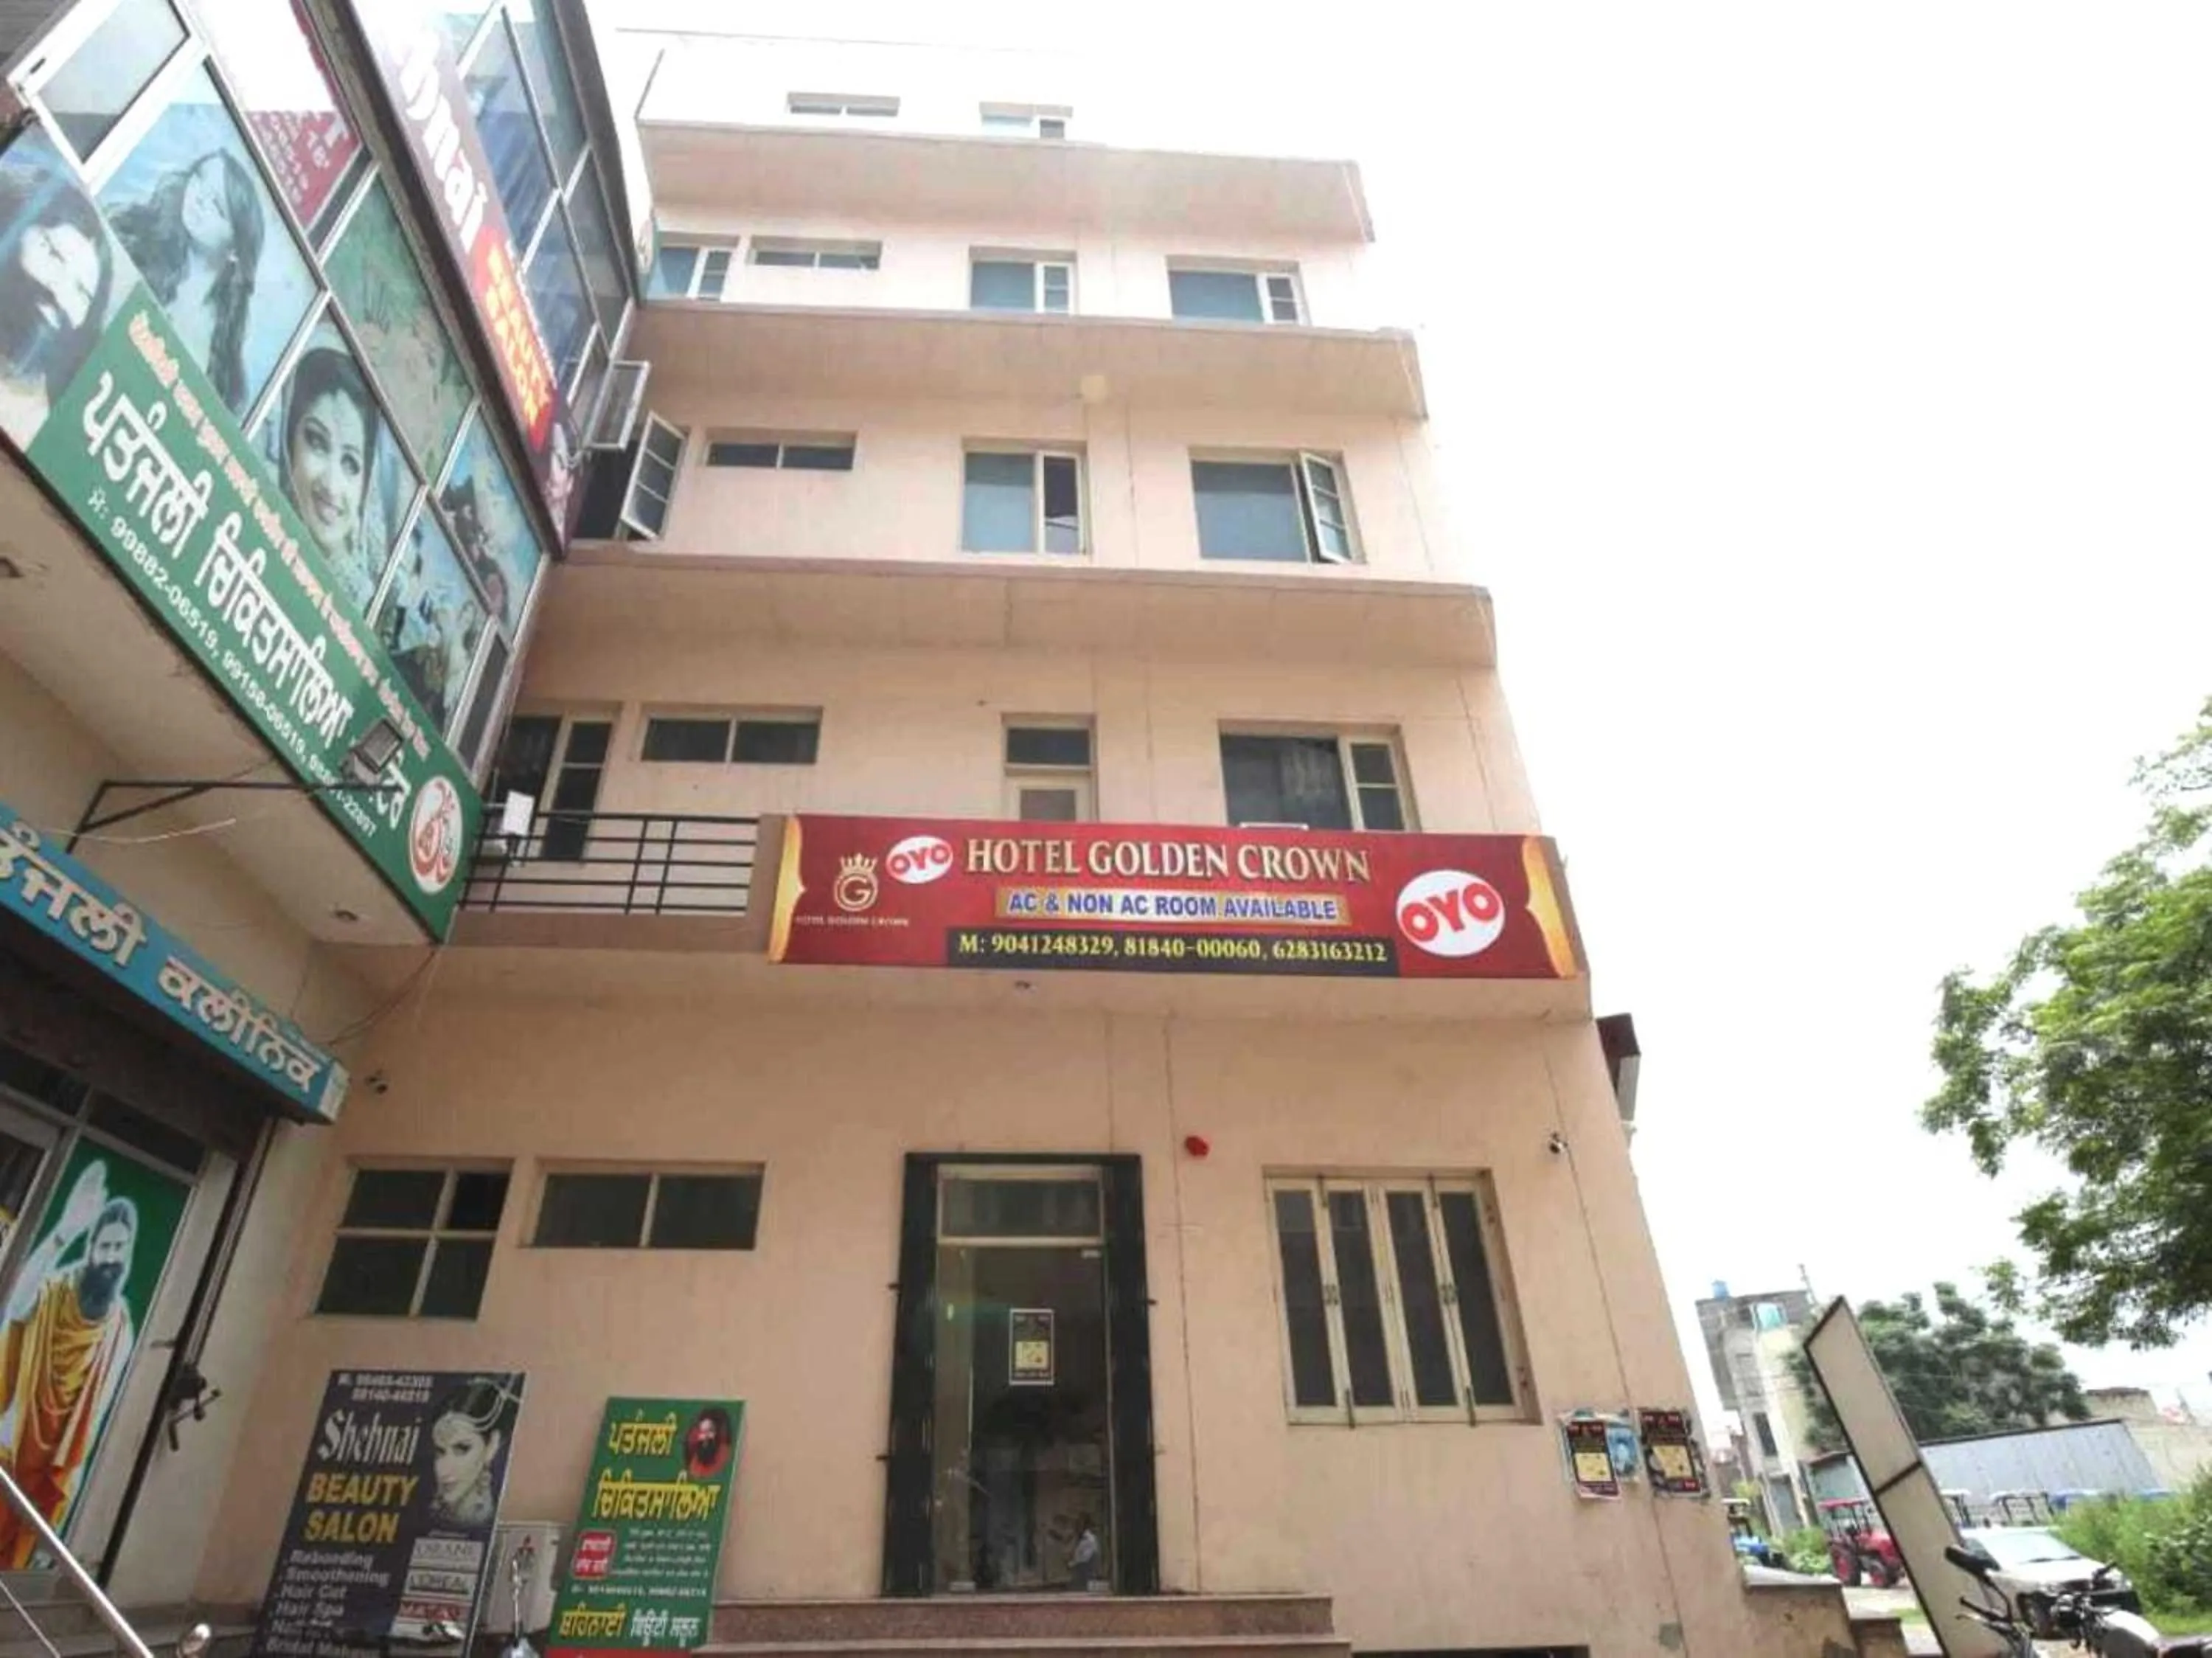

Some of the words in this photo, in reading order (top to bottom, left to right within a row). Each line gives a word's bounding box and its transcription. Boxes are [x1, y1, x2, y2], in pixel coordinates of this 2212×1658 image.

[80, 370, 212, 561] ਪਤੰਜਲੀ
[889, 844, 950, 875] OYO
[967, 839, 1082, 874] HOTEL
[1088, 841, 1229, 877] GOLDEN
[1238, 845, 1371, 881] CROWN
[1010, 894, 1037, 912] AC
[1046, 894, 1059, 912] &
[1068, 894, 1113, 914] NON
[1120, 895, 1148, 915] AC
[1155, 895, 1217, 917] ROOM
[1224, 898, 1337, 920] AVAILABLE
[1402, 882, 1500, 943] OYO
[959, 934, 986, 954] M:
[1273, 942, 1388, 962] 6283163212
[319, 1409, 422, 1464] Shehnai
[608, 1409, 676, 1456] ਪਤੰਜਲੀ
[307, 1474, 417, 1506] BEAUTY
[306, 1511, 399, 1543] SALON
